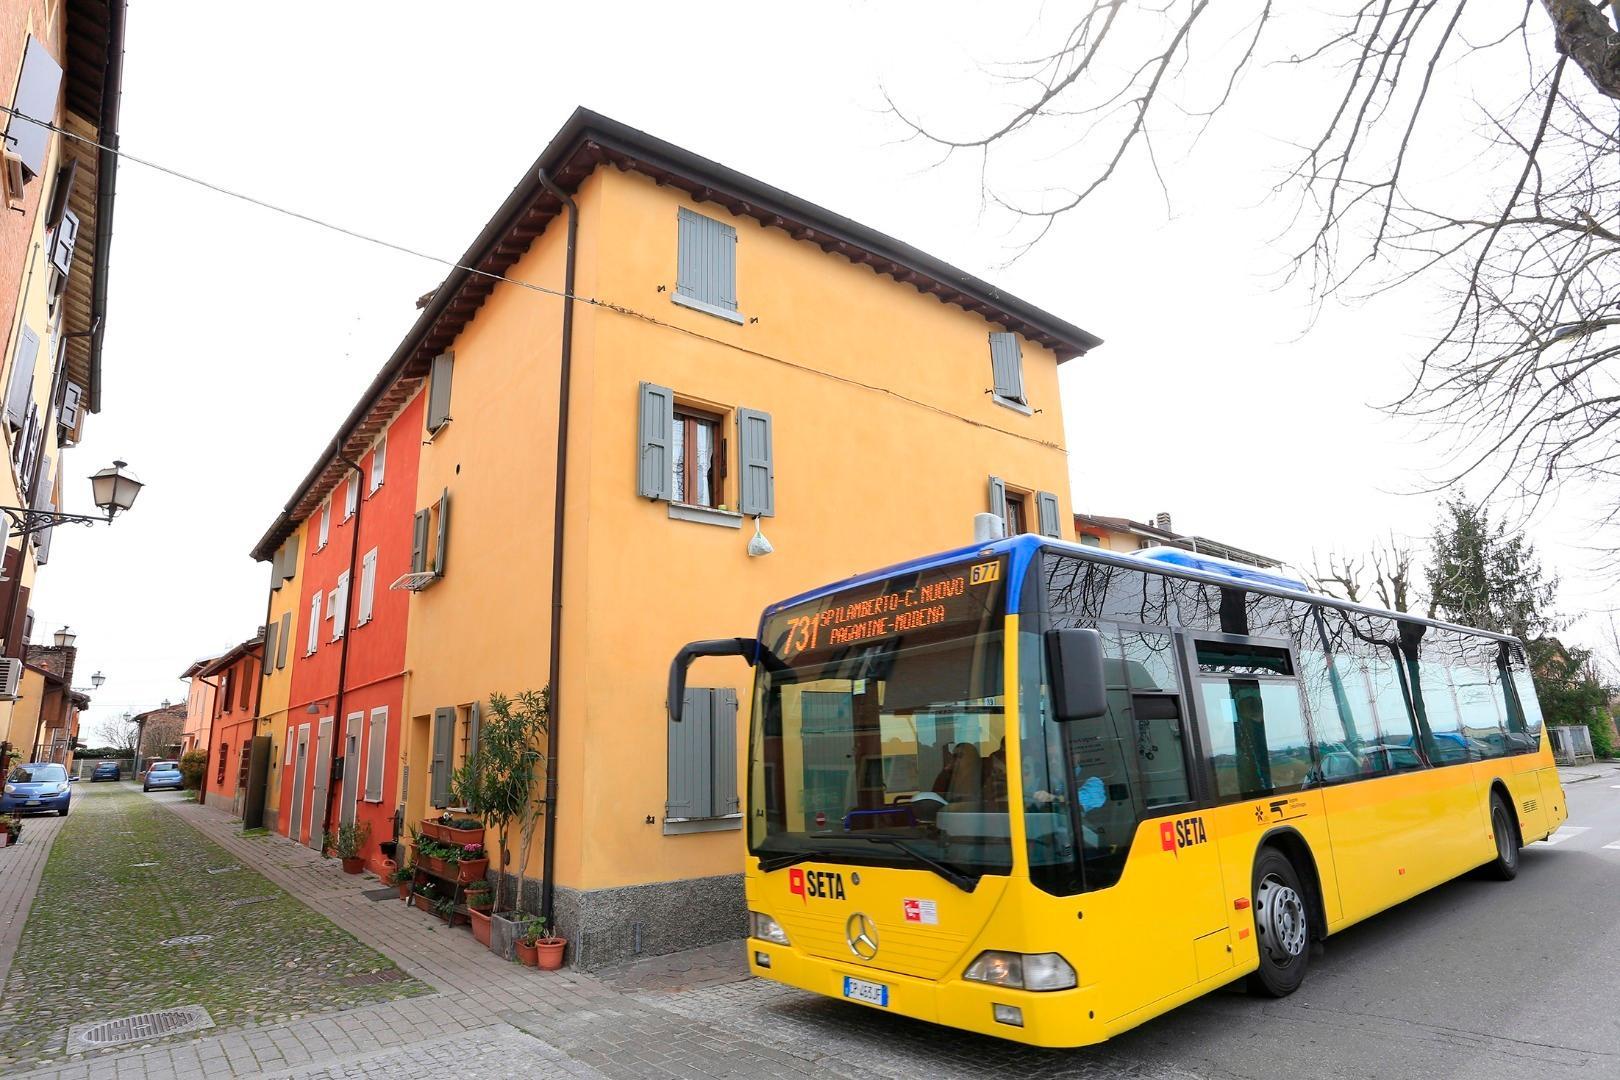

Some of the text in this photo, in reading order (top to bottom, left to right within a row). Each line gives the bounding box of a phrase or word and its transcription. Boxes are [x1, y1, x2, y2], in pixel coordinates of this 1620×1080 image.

[973, 563, 998, 581] 677
[921, 577, 964, 602] NUOVO
[784, 613, 820, 655] 731
[1175, 817, 1207, 848] SETA
[806, 870, 846, 900] SETA
